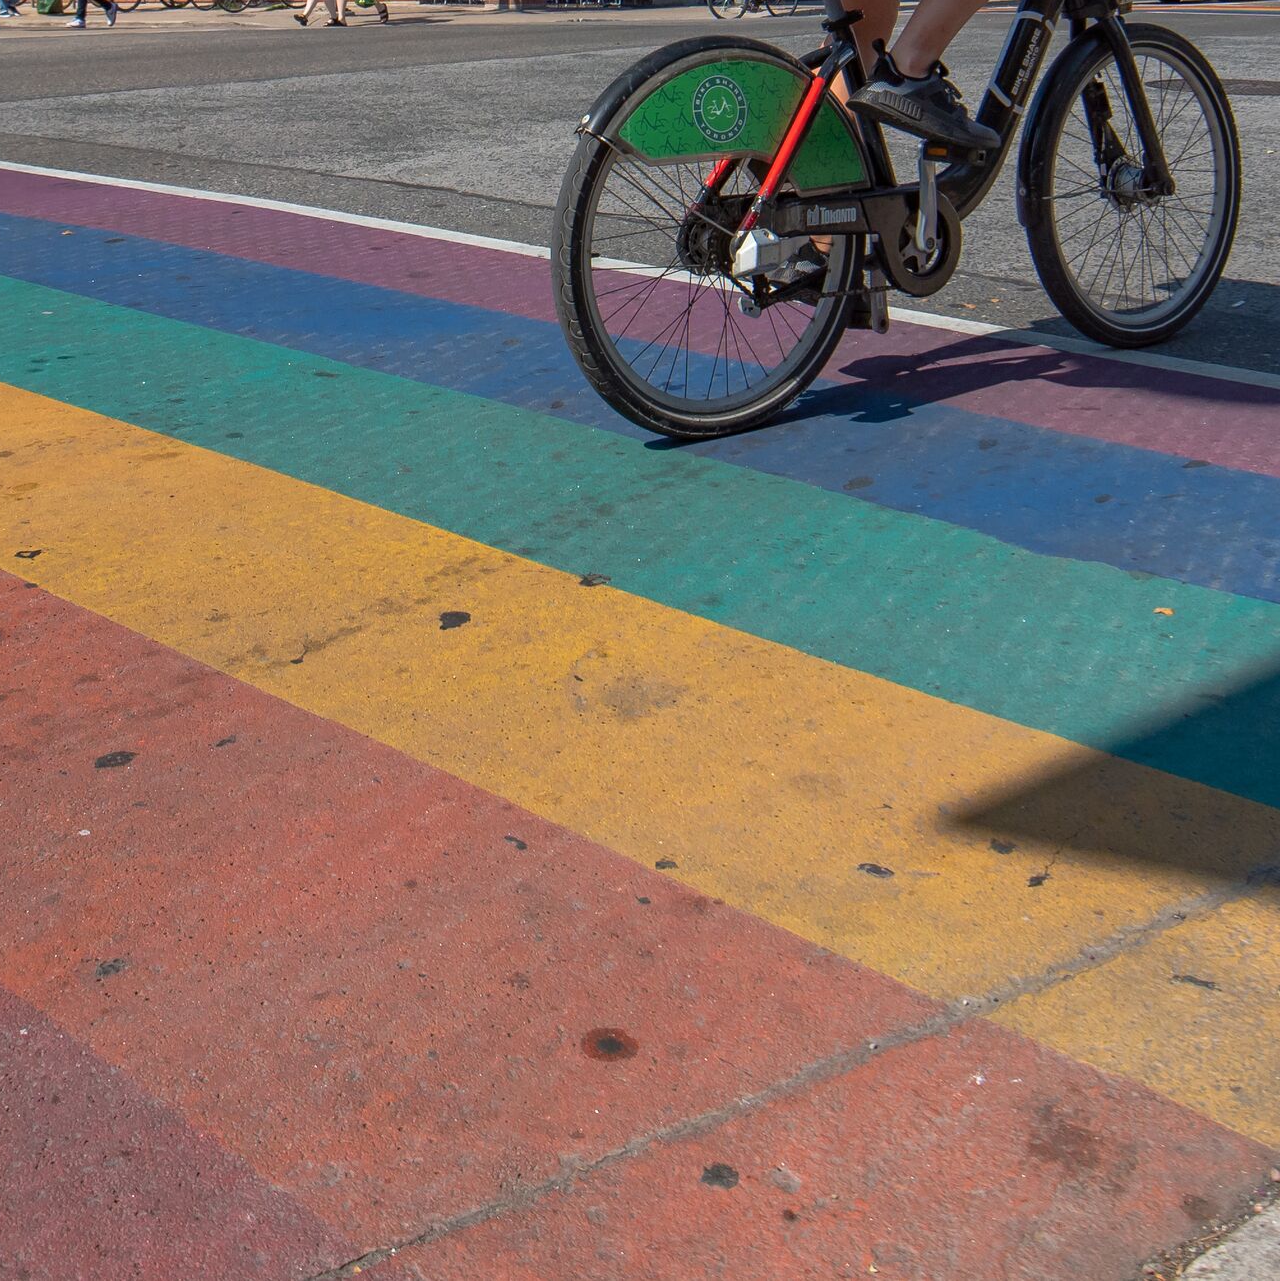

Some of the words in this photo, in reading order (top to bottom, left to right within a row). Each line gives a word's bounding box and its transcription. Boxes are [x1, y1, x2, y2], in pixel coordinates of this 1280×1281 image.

[695, 81, 711, 105] BIKE
[714, 78, 744, 102] SHARE
[699, 119, 743, 140] TORONTO
[820, 207, 857, 225] TORONTO
